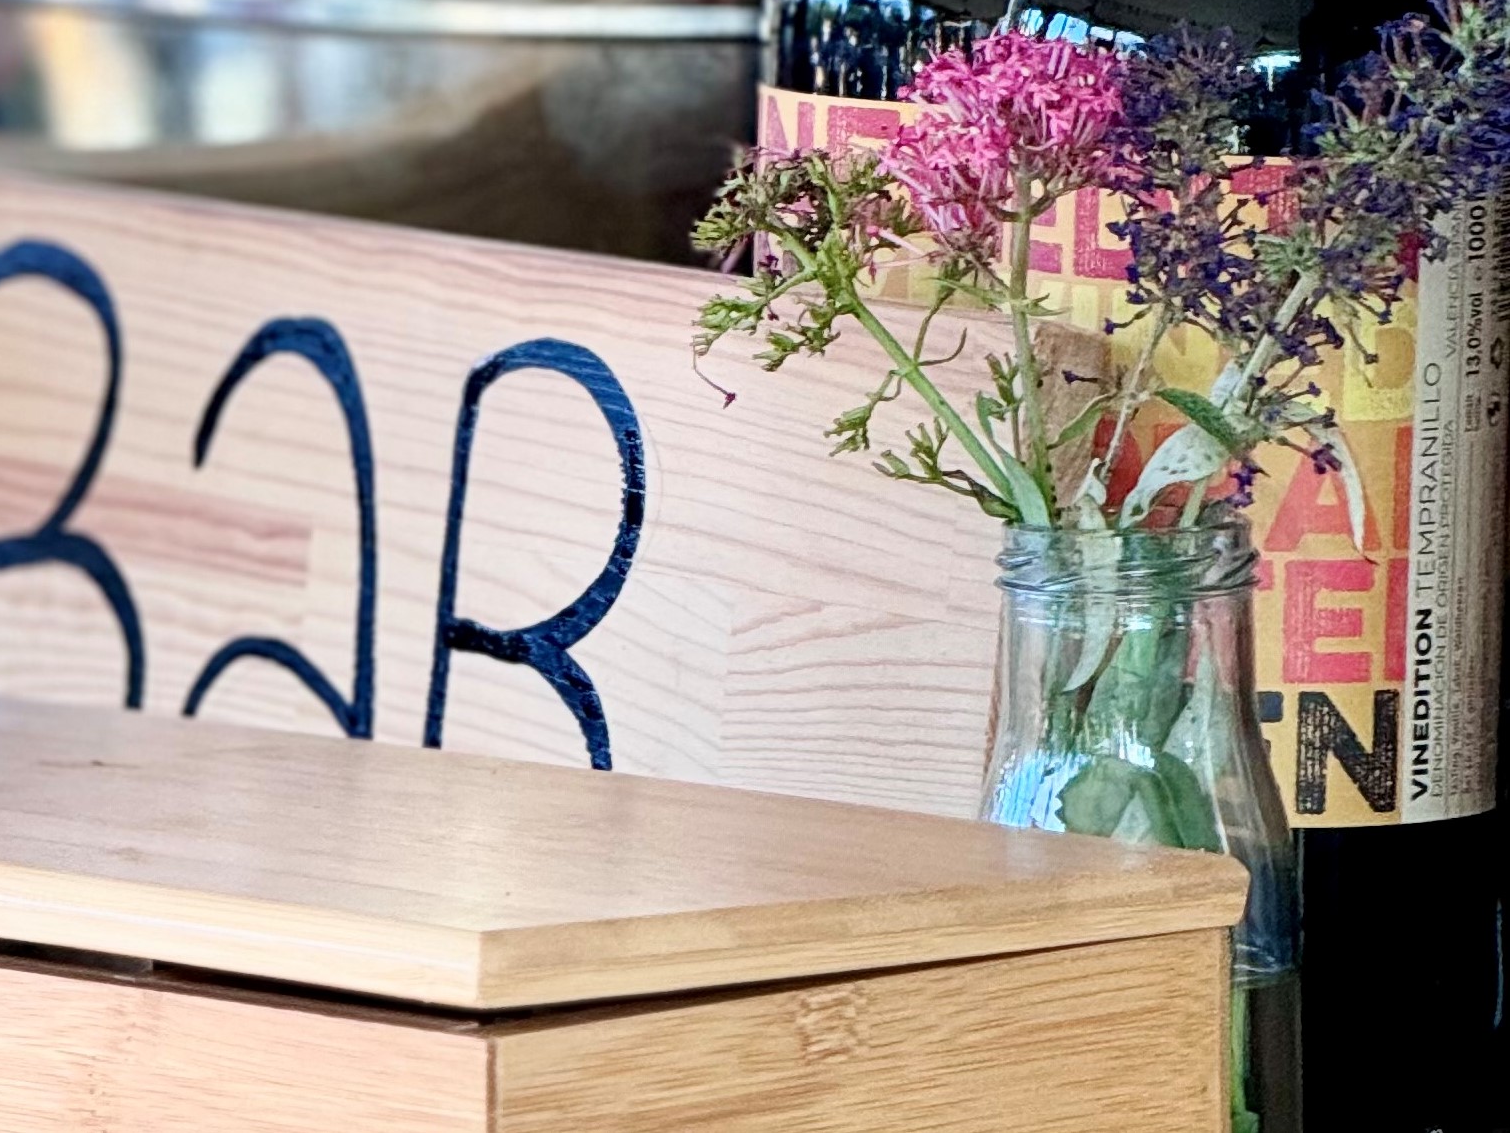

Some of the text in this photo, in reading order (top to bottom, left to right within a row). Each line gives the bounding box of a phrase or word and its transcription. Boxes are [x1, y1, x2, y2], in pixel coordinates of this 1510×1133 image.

[1410, 362, 1441, 801] VINEDITION TEMPRANILLO
[1436, 613, 1449, 639] DE
